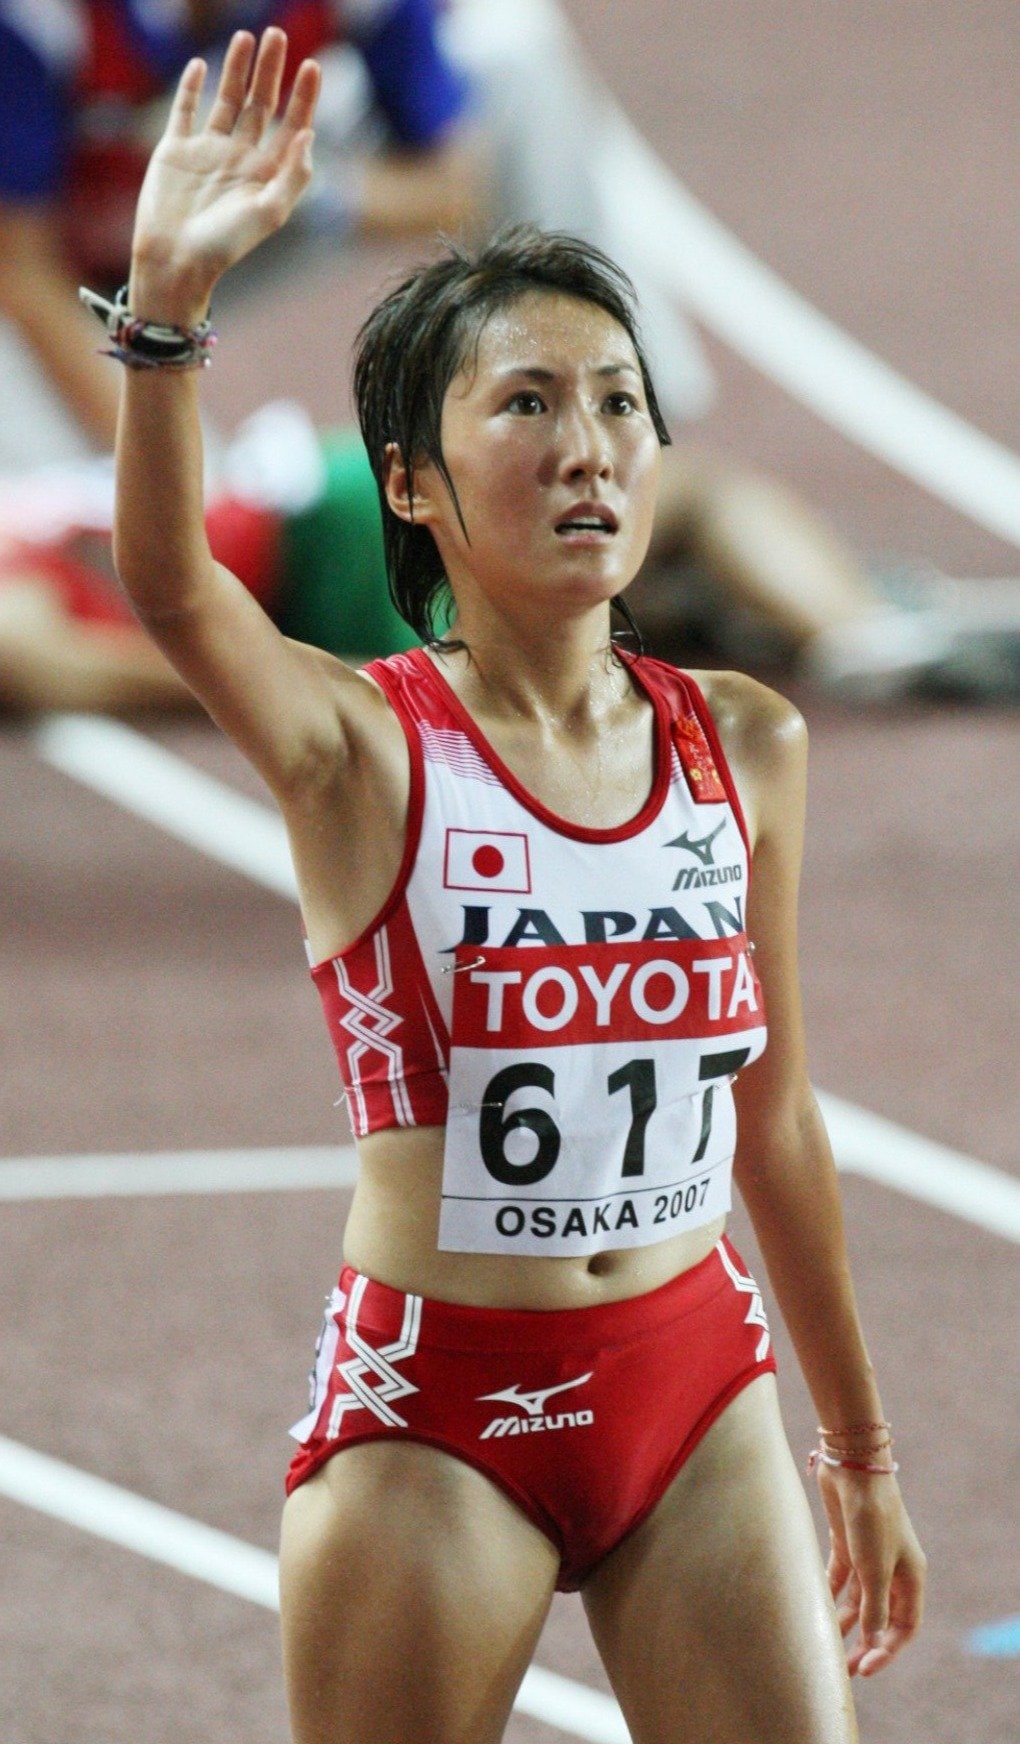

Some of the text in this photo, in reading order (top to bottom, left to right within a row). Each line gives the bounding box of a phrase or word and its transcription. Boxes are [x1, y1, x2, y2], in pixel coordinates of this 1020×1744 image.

[438, 896, 744, 953] JAPAN
[470, 953, 758, 1032] TOYOTA
[479, 1047, 750, 1186] 617
[495, 1178, 711, 1238] OSAKA 2007
